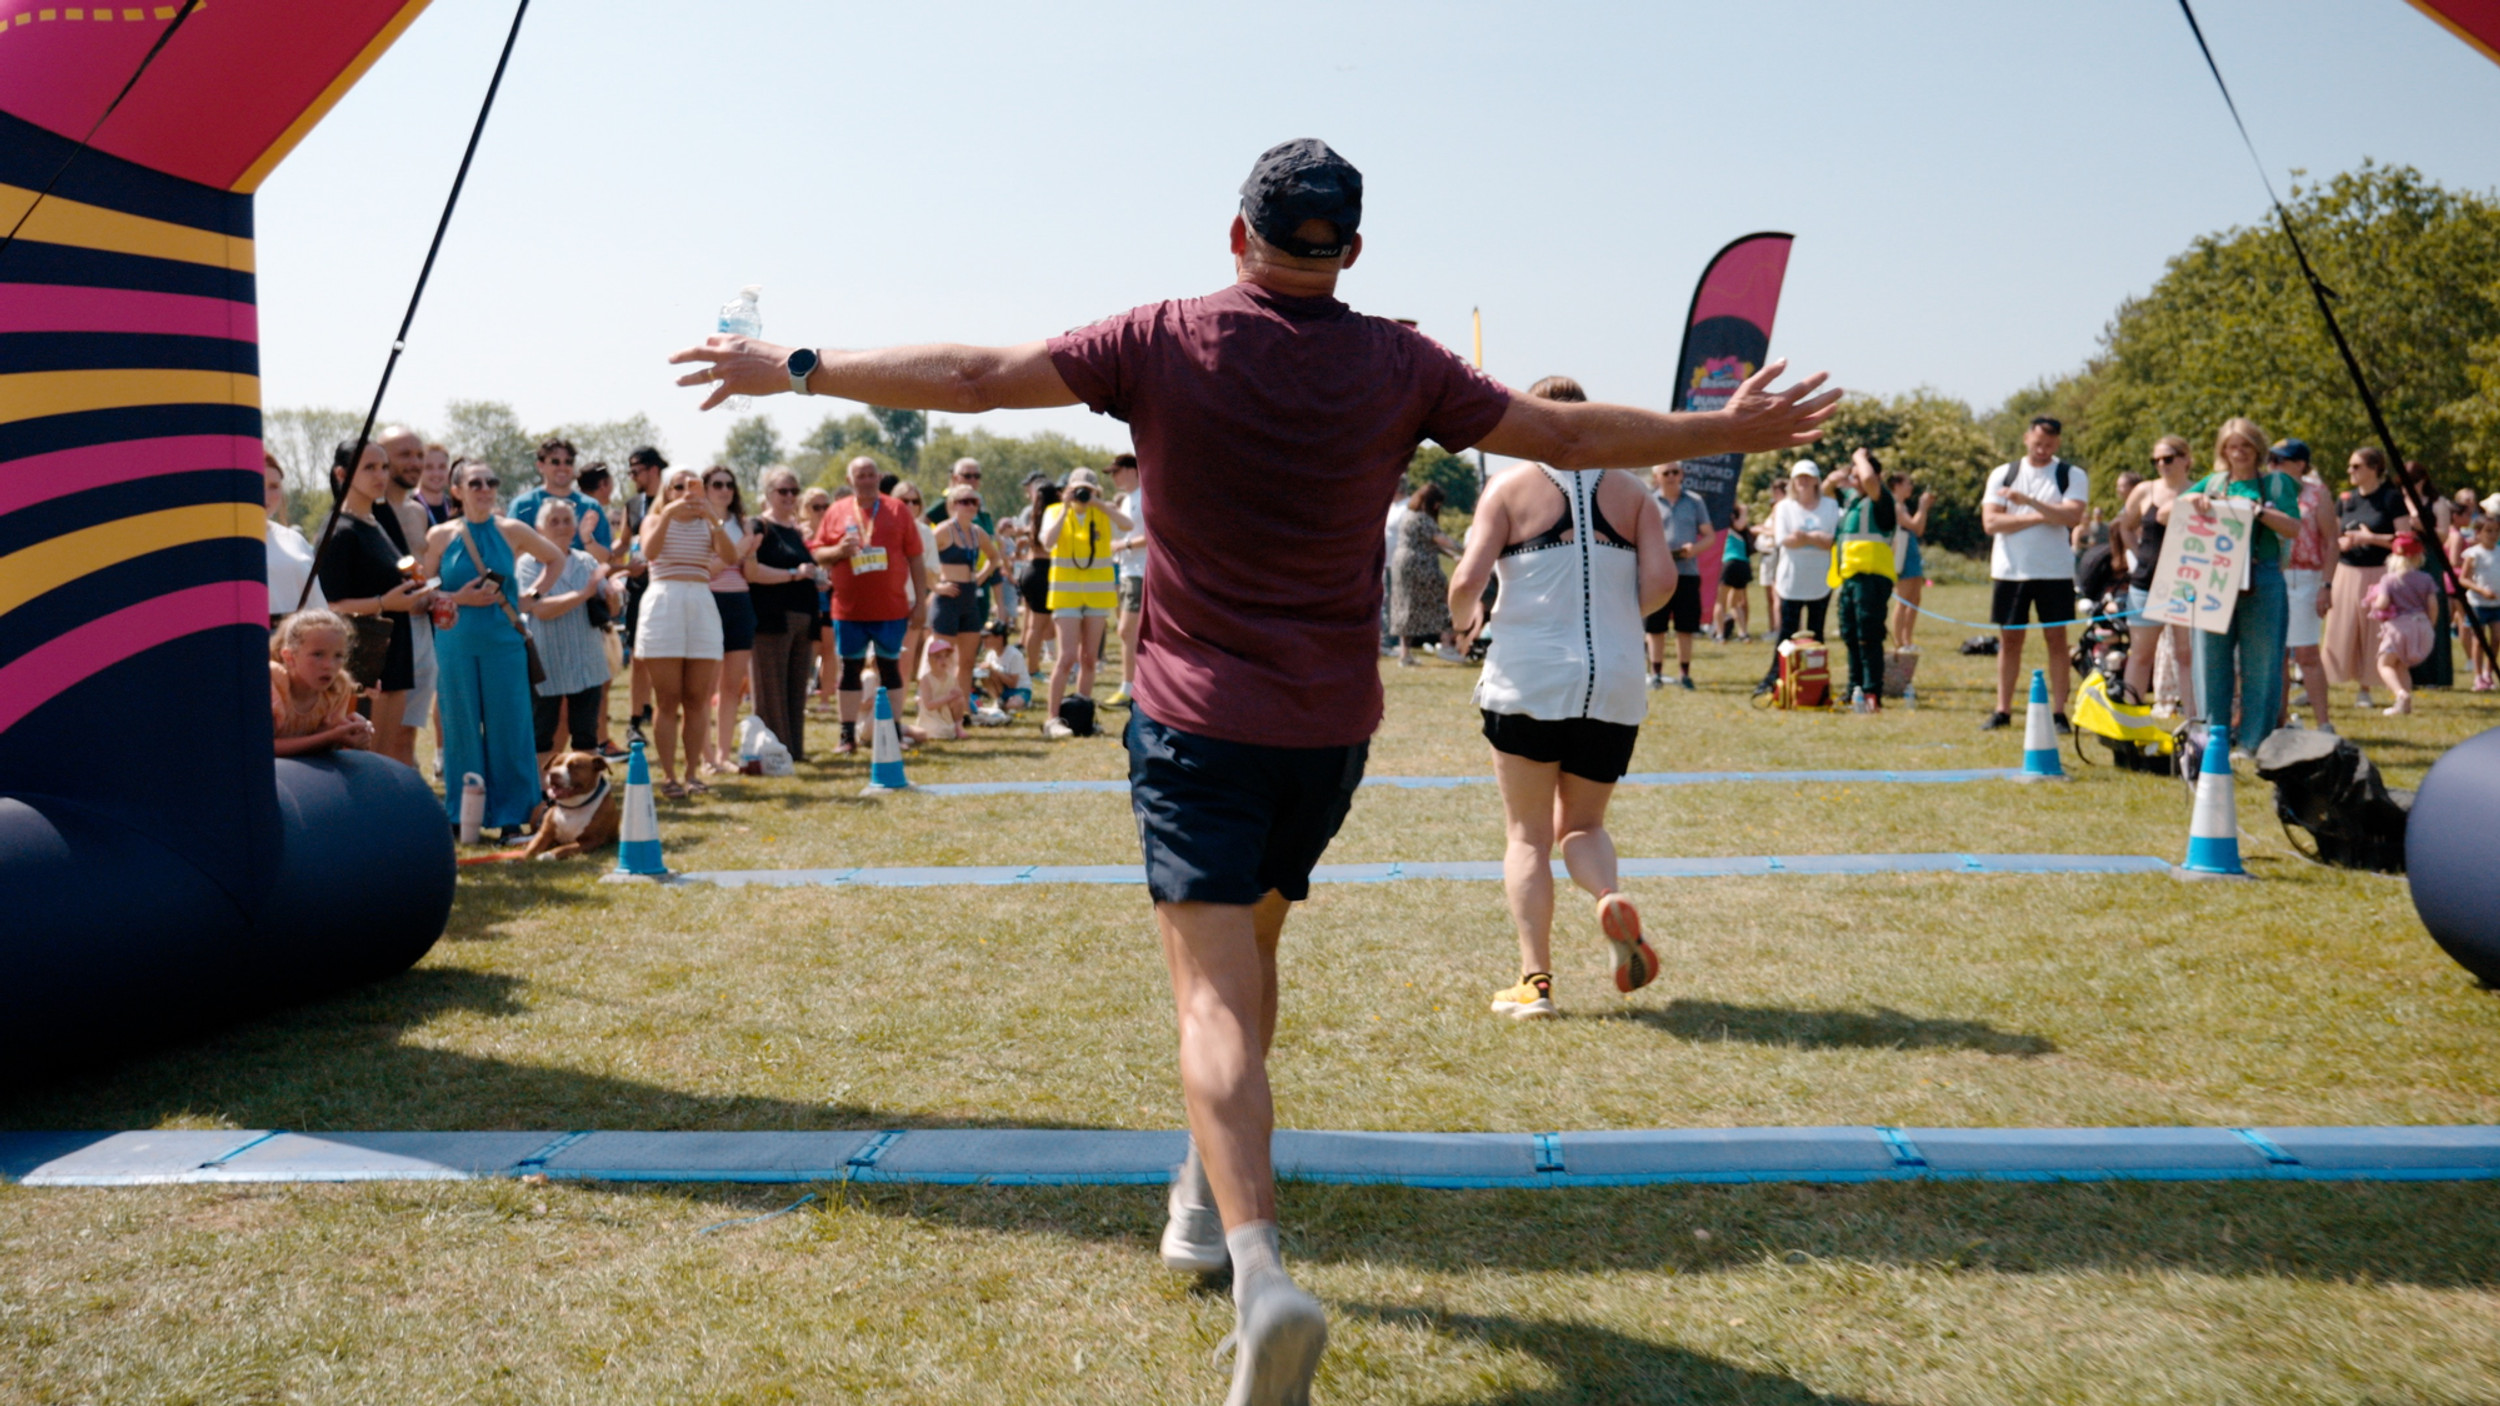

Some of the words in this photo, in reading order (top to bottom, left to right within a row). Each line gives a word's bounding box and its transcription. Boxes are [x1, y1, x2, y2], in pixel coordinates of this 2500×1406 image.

[1683, 462, 1735, 479] ORTFORD
[1683, 477, 1724, 494] OLLEGE
[2202, 517, 2245, 612] FORZA
